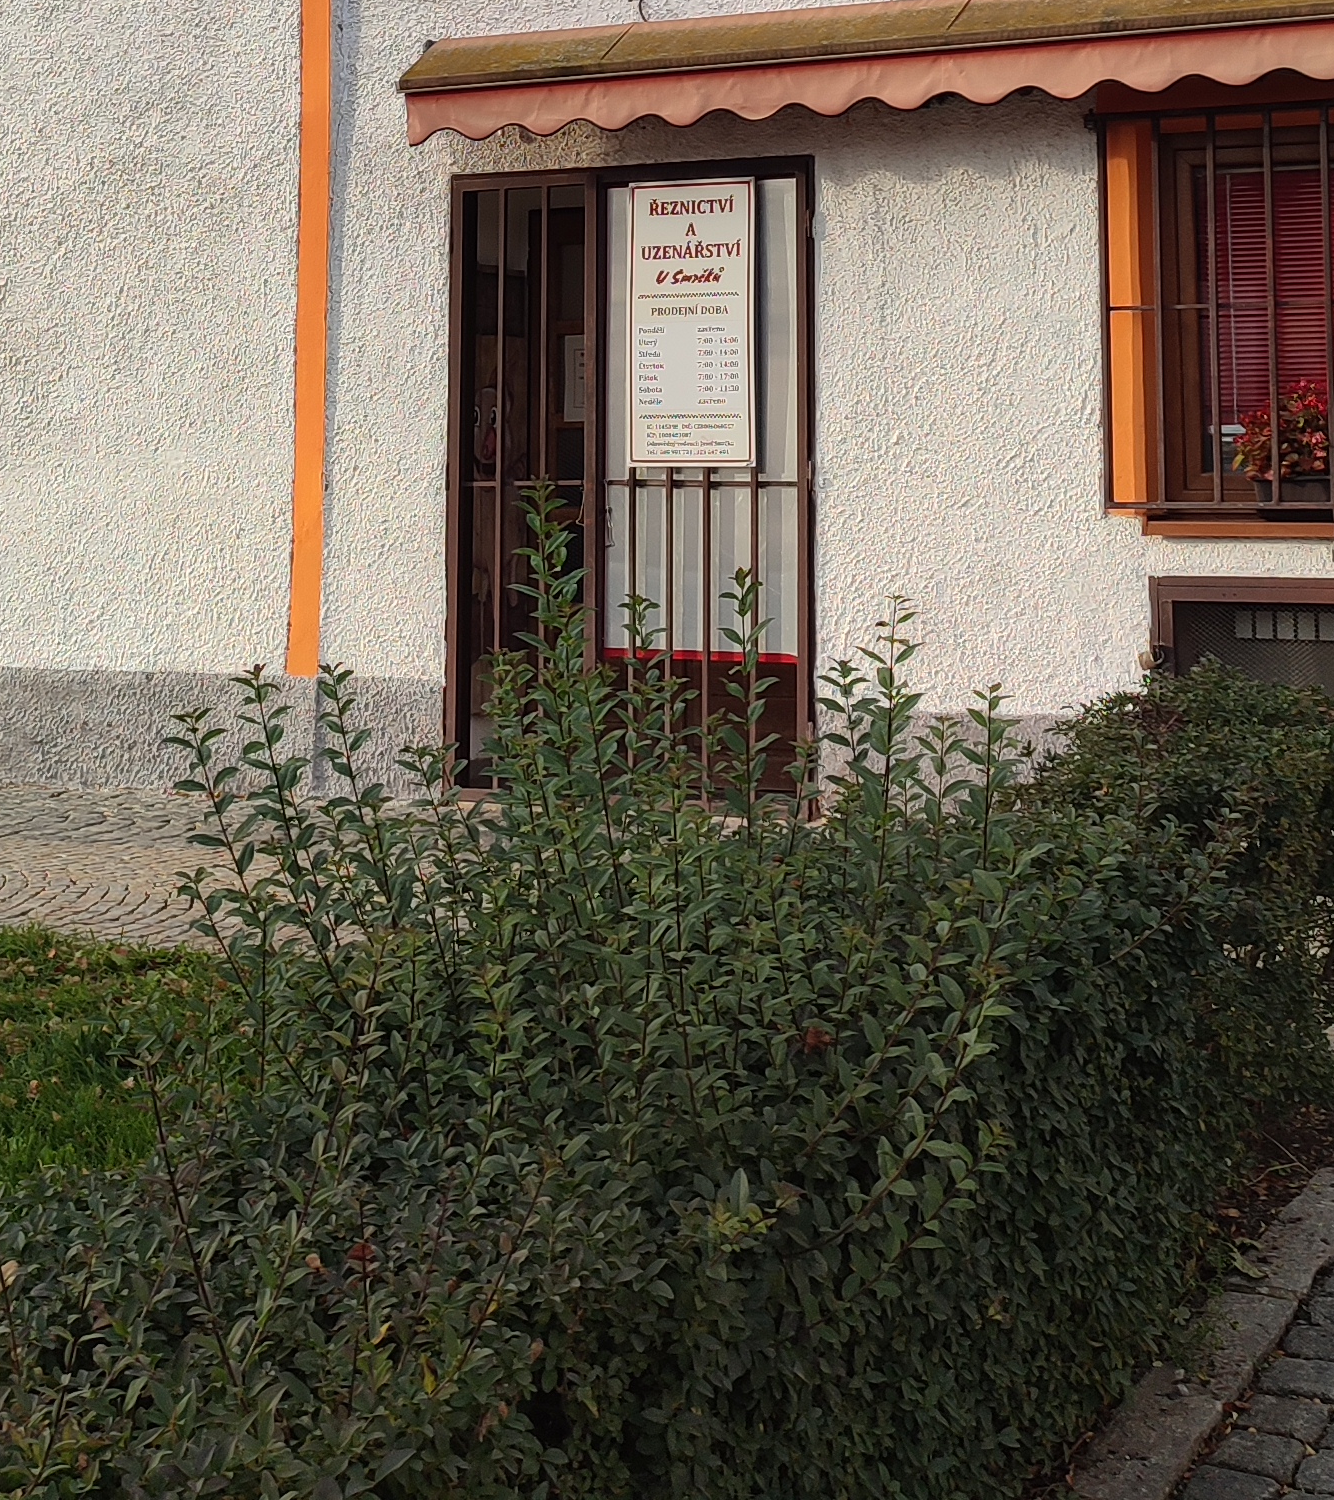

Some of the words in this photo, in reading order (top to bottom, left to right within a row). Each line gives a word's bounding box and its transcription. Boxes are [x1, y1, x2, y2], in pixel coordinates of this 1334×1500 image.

[649, 194, 734, 216] ŘEZNICTVÍ
[685, 221, 697, 237] A
[641, 238, 742, 260] UZENÁŘSTVÍ
[656, 269, 670, 285] U
[651, 302, 698, 317] PRODEJNÍ
[701, 305, 729, 316] DOBA
